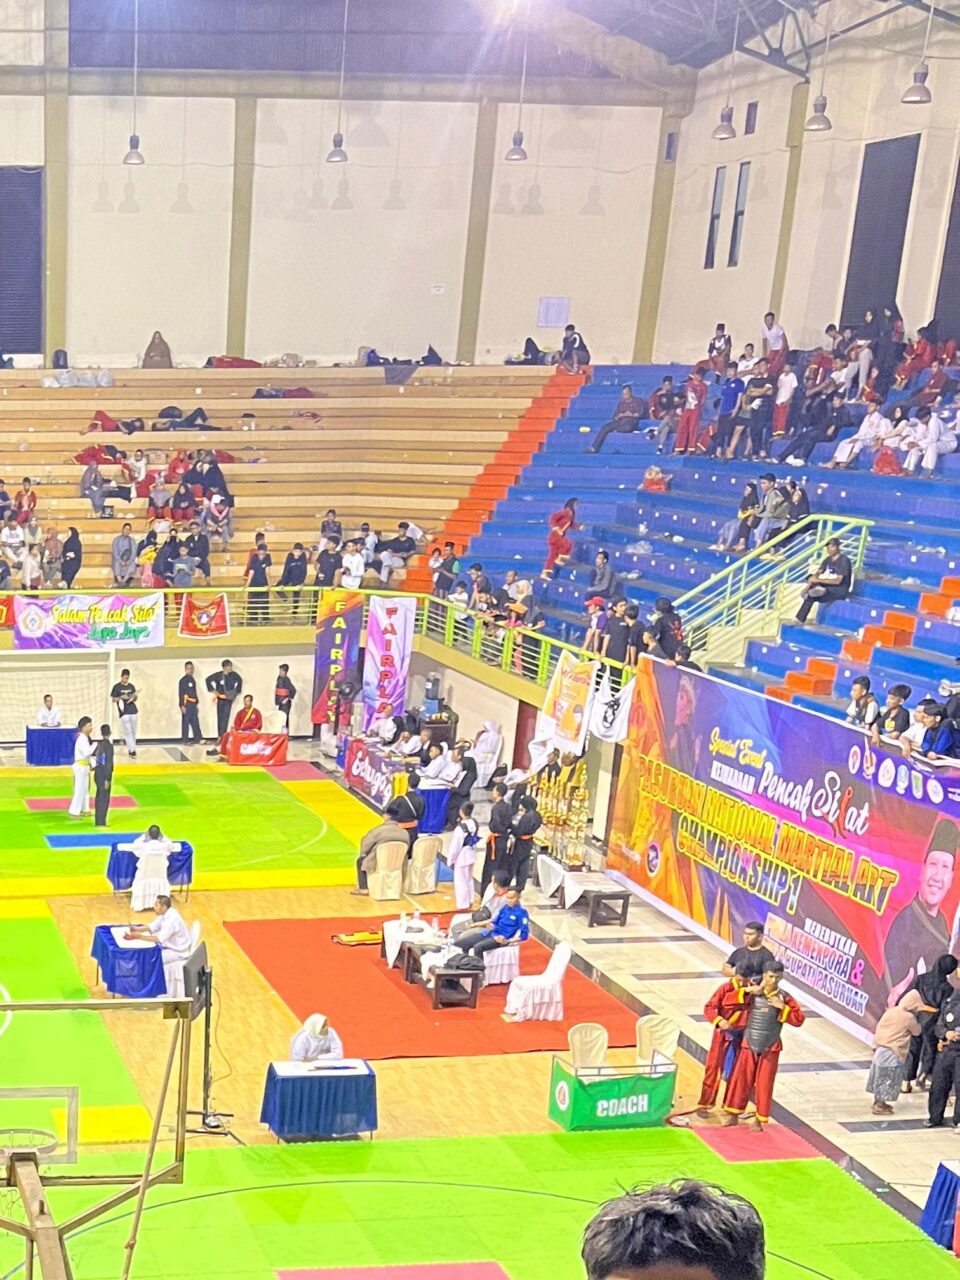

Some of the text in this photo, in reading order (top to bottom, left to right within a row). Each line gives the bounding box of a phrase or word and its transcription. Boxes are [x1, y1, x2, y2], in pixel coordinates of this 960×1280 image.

[375, 607, 399, 720] FAIRPLA
[758, 761, 815, 823] Pencak
[676, 813, 803, 915] CHAMPIONSHIP 1
[701, 785, 779, 855] NATIONAL
[775, 820, 855, 896] MARTIAL
[851, 855, 899, 916] ART
[596, 1093, 649, 1117] COACH
